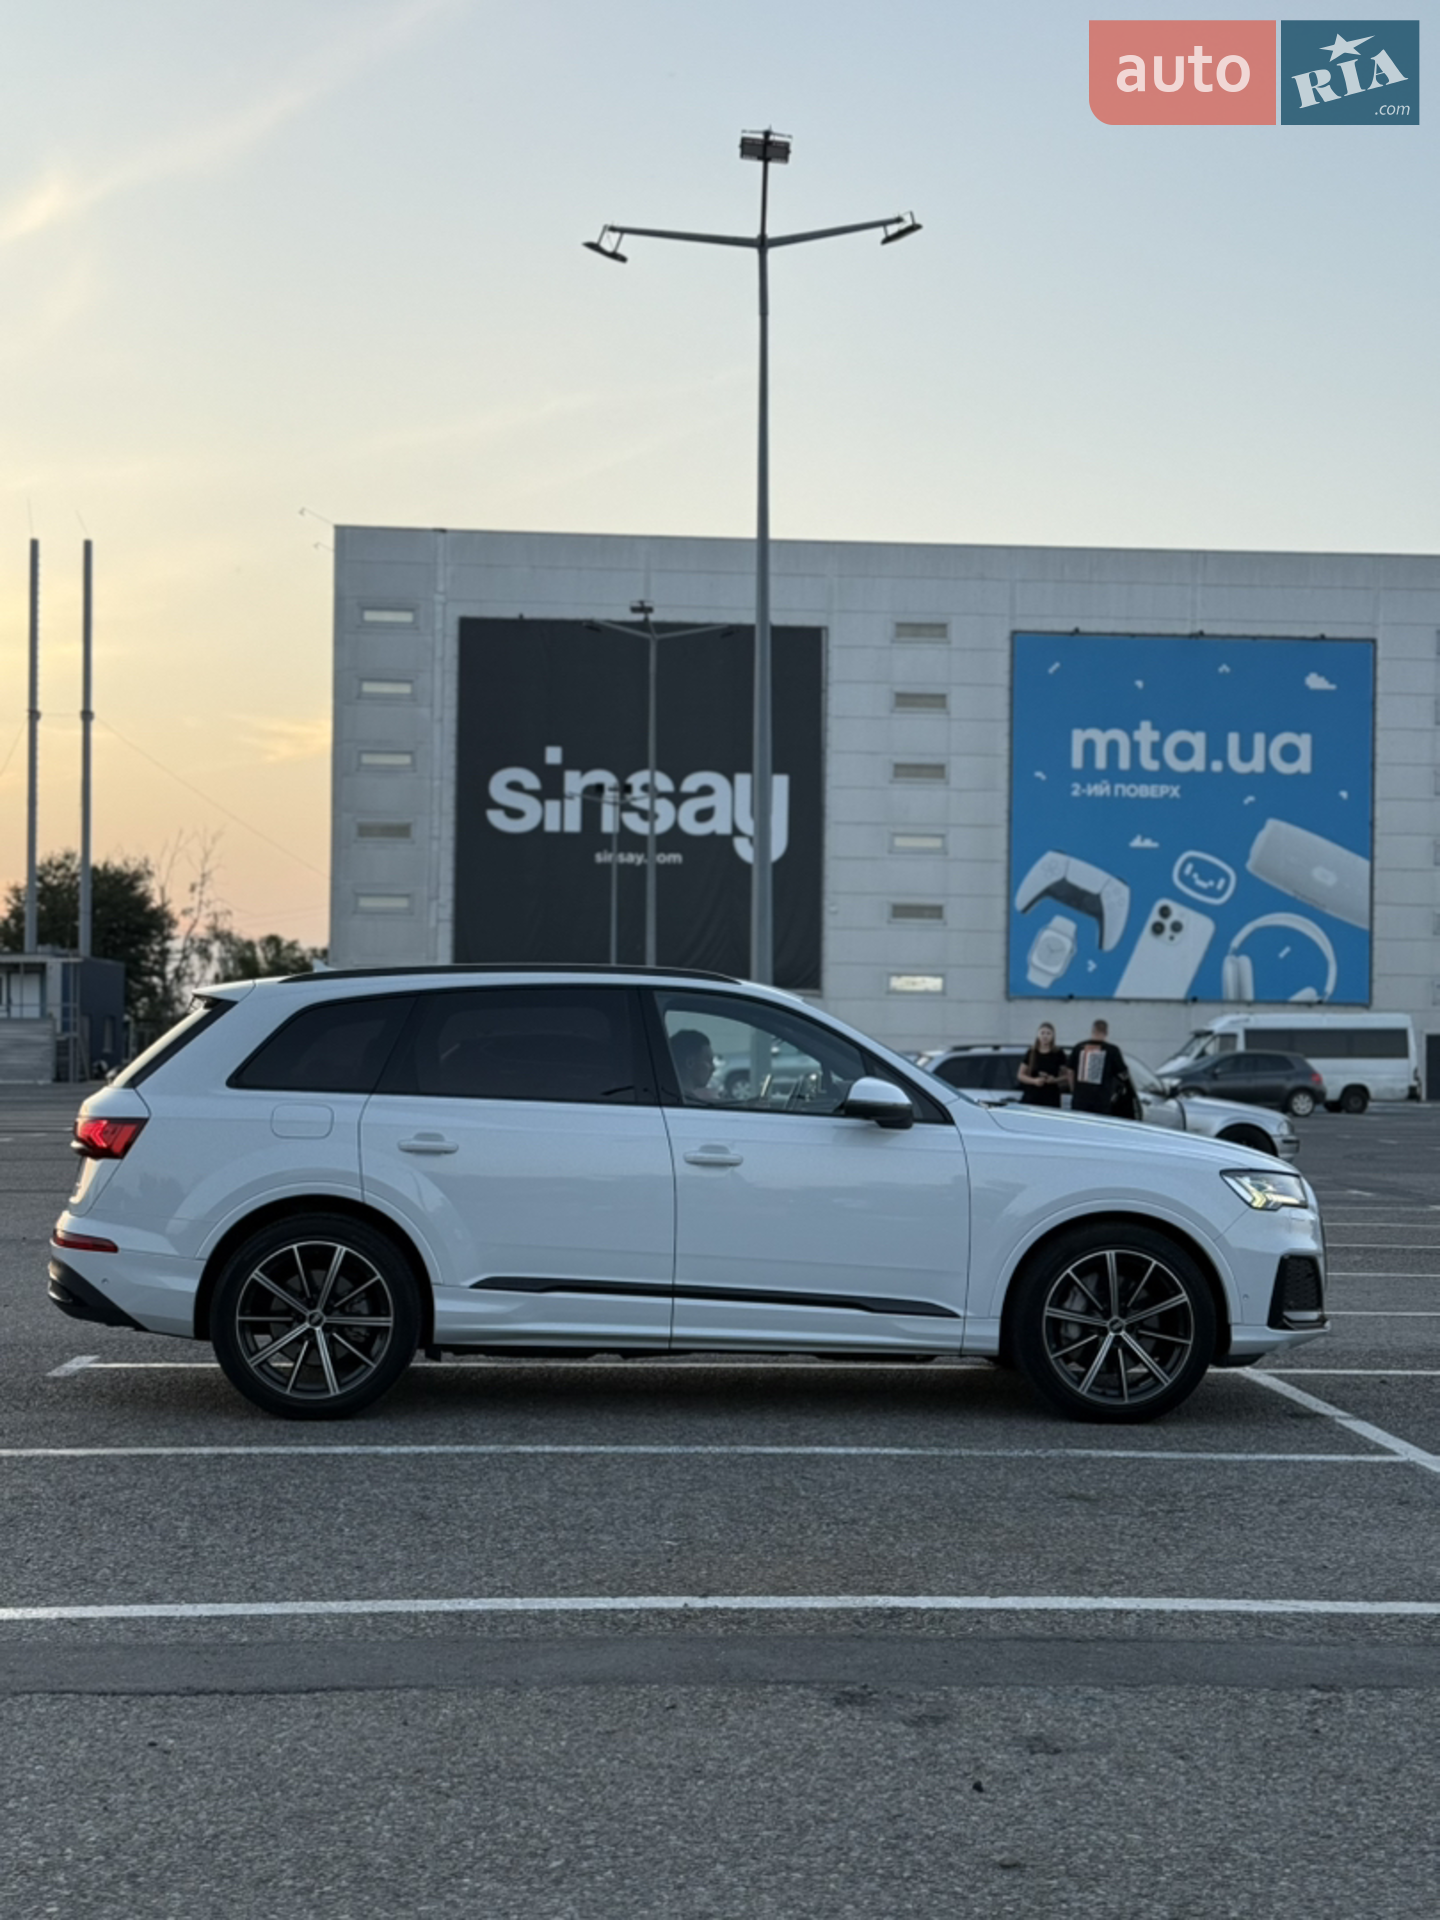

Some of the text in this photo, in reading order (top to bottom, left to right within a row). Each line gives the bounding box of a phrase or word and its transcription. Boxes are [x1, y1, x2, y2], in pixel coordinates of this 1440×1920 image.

[1071, 720, 1312, 775] mta.ua
[486, 746, 789, 864] sinsay
[1071, 780, 1181, 799] 2-ИЙ ПОВЕРХ
[594, 850, 683, 866] sisay.om
